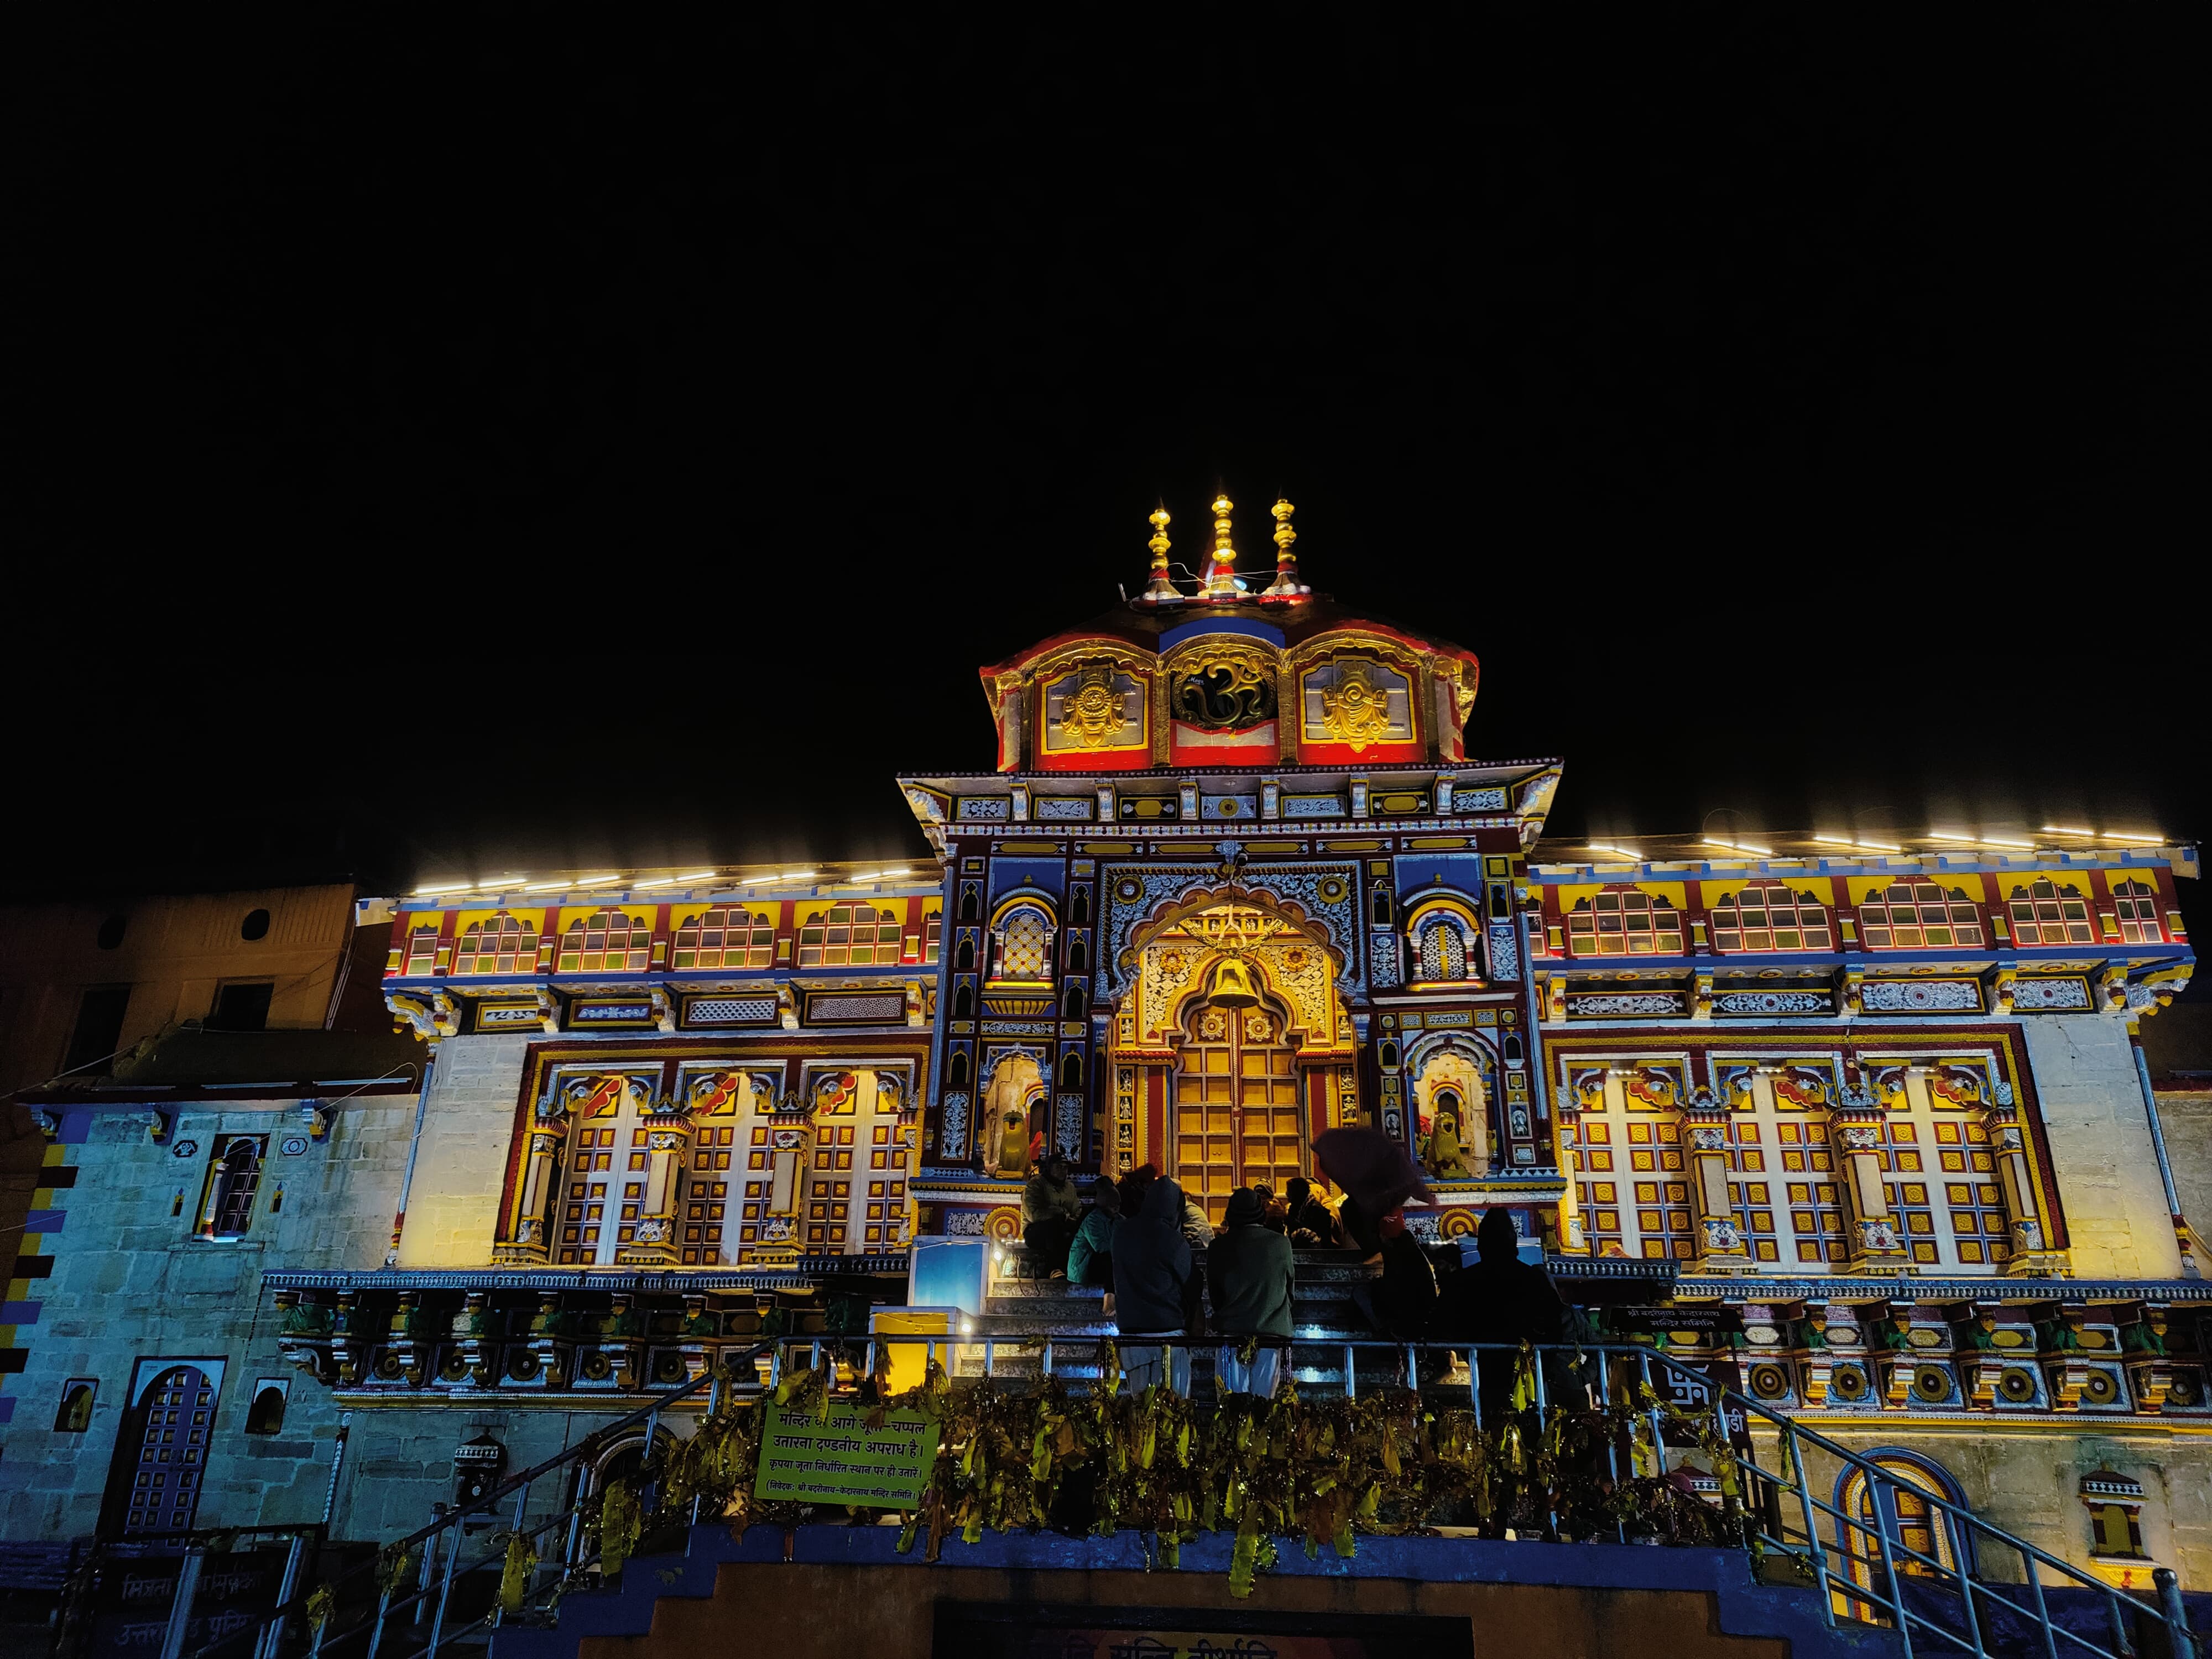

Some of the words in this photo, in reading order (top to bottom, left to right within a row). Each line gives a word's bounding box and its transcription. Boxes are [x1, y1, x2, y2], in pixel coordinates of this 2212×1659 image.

[778, 1411, 812, 1428] मन्दिर
[814, 1415, 828, 1428] क
[831, 1413, 857, 1430] आगे
[773, 1435, 814, 1449] उतारना
[816, 1435, 862, 1453] दण्डनीय
[865, 1442, 907, 1456] अपराध
[769, 1459, 794, 1471] कृपया
[795, 1461, 813, 1473] जूता
[815, 1459, 848, 1473] निर्धारित
[849, 1465, 872, 1475] स्थान
[873, 1467, 885, 1476] पर
[886, 1464, 896, 1478] ही
[797, 1482, 806, 1491] श्री
[870, 1487, 889, 1498] मन्दिर
